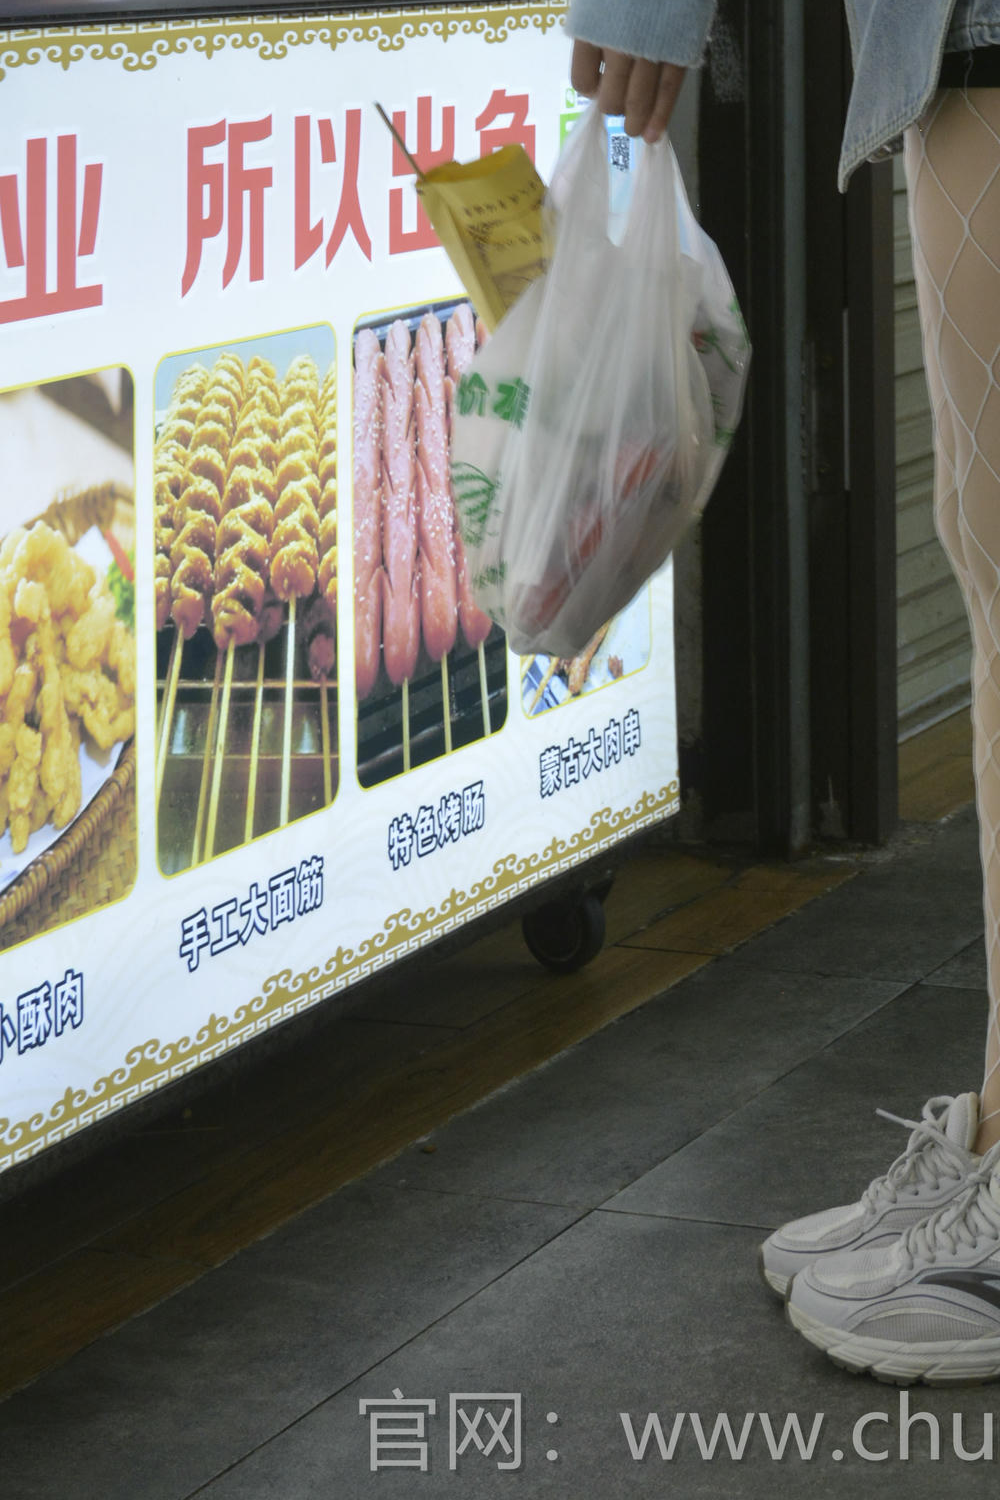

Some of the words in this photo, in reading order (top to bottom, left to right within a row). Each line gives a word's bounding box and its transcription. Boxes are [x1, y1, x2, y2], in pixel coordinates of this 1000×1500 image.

[0, 134, 103, 325] 业
[540, 708, 641, 798] 蒙古大肉串
[388, 780, 485, 870] 特色烤肠
[180, 856, 324, 972] 手工大面筋
